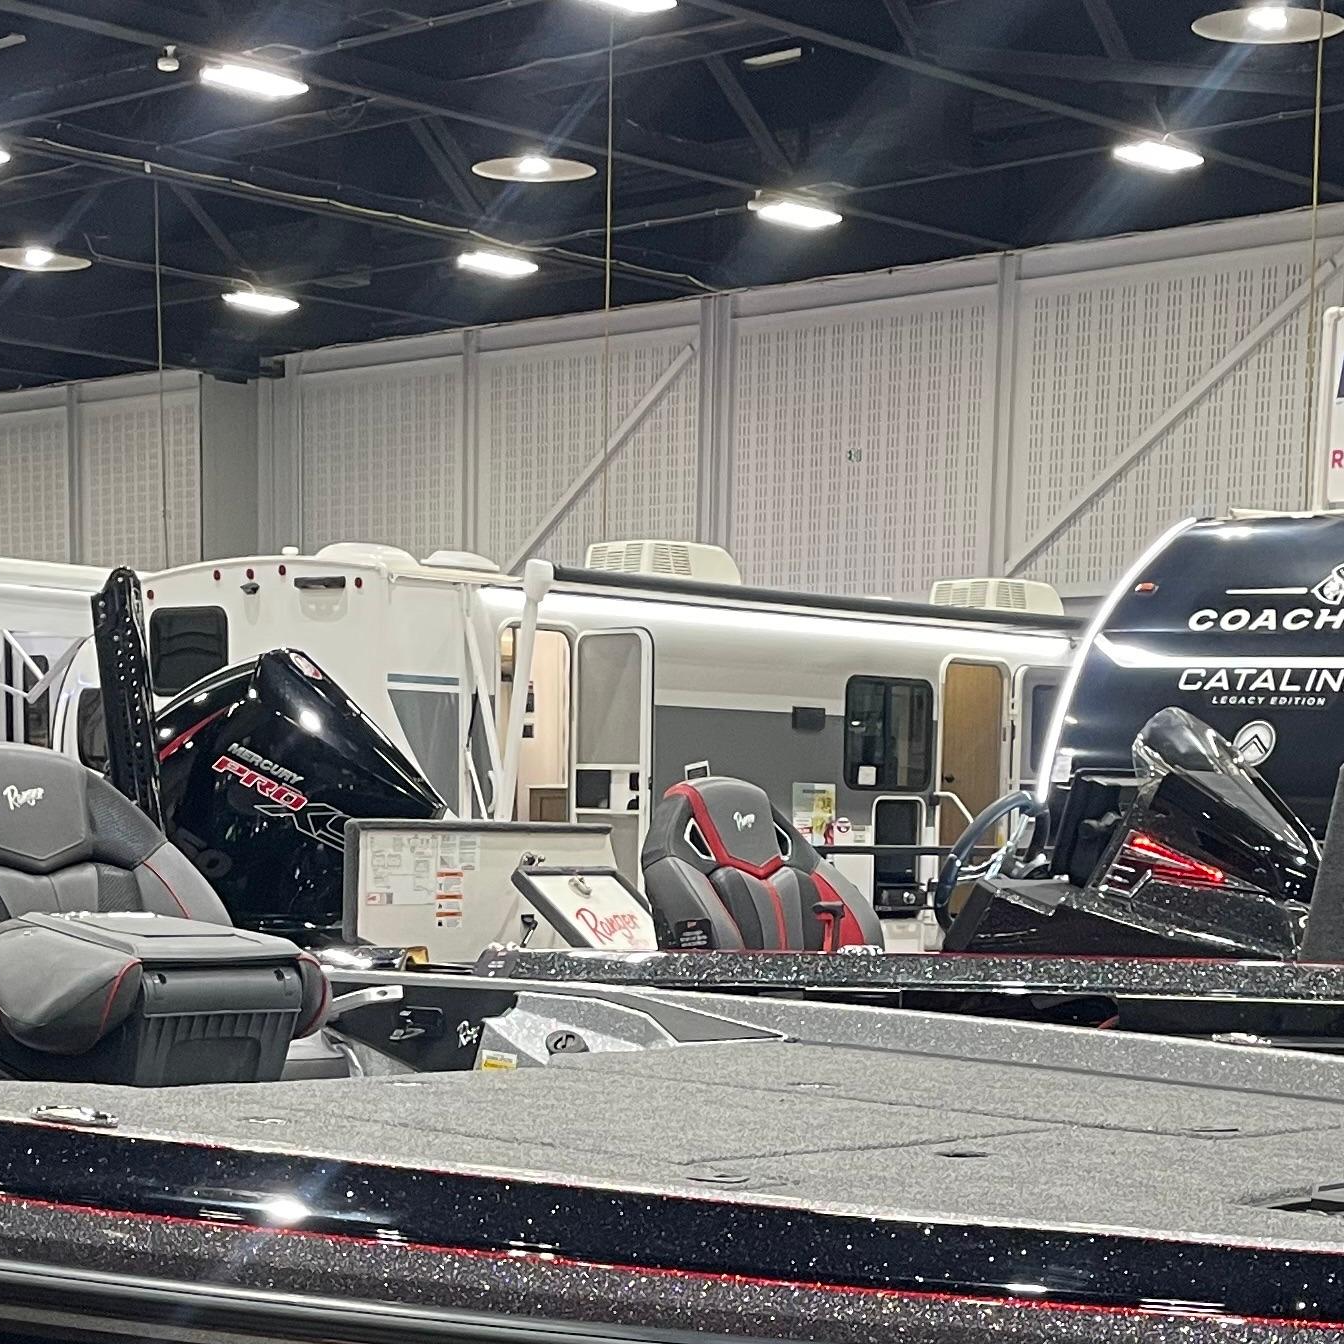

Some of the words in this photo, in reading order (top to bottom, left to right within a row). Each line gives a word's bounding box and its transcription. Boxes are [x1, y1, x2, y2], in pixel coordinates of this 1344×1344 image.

[1211, 695, 1264, 705] LEGACY
[1270, 696, 1326, 706] EDITION
[211, 755, 308, 812] PRO
[227, 742, 304, 785] MERCURY
[575, 907, 640, 945] Ranger
